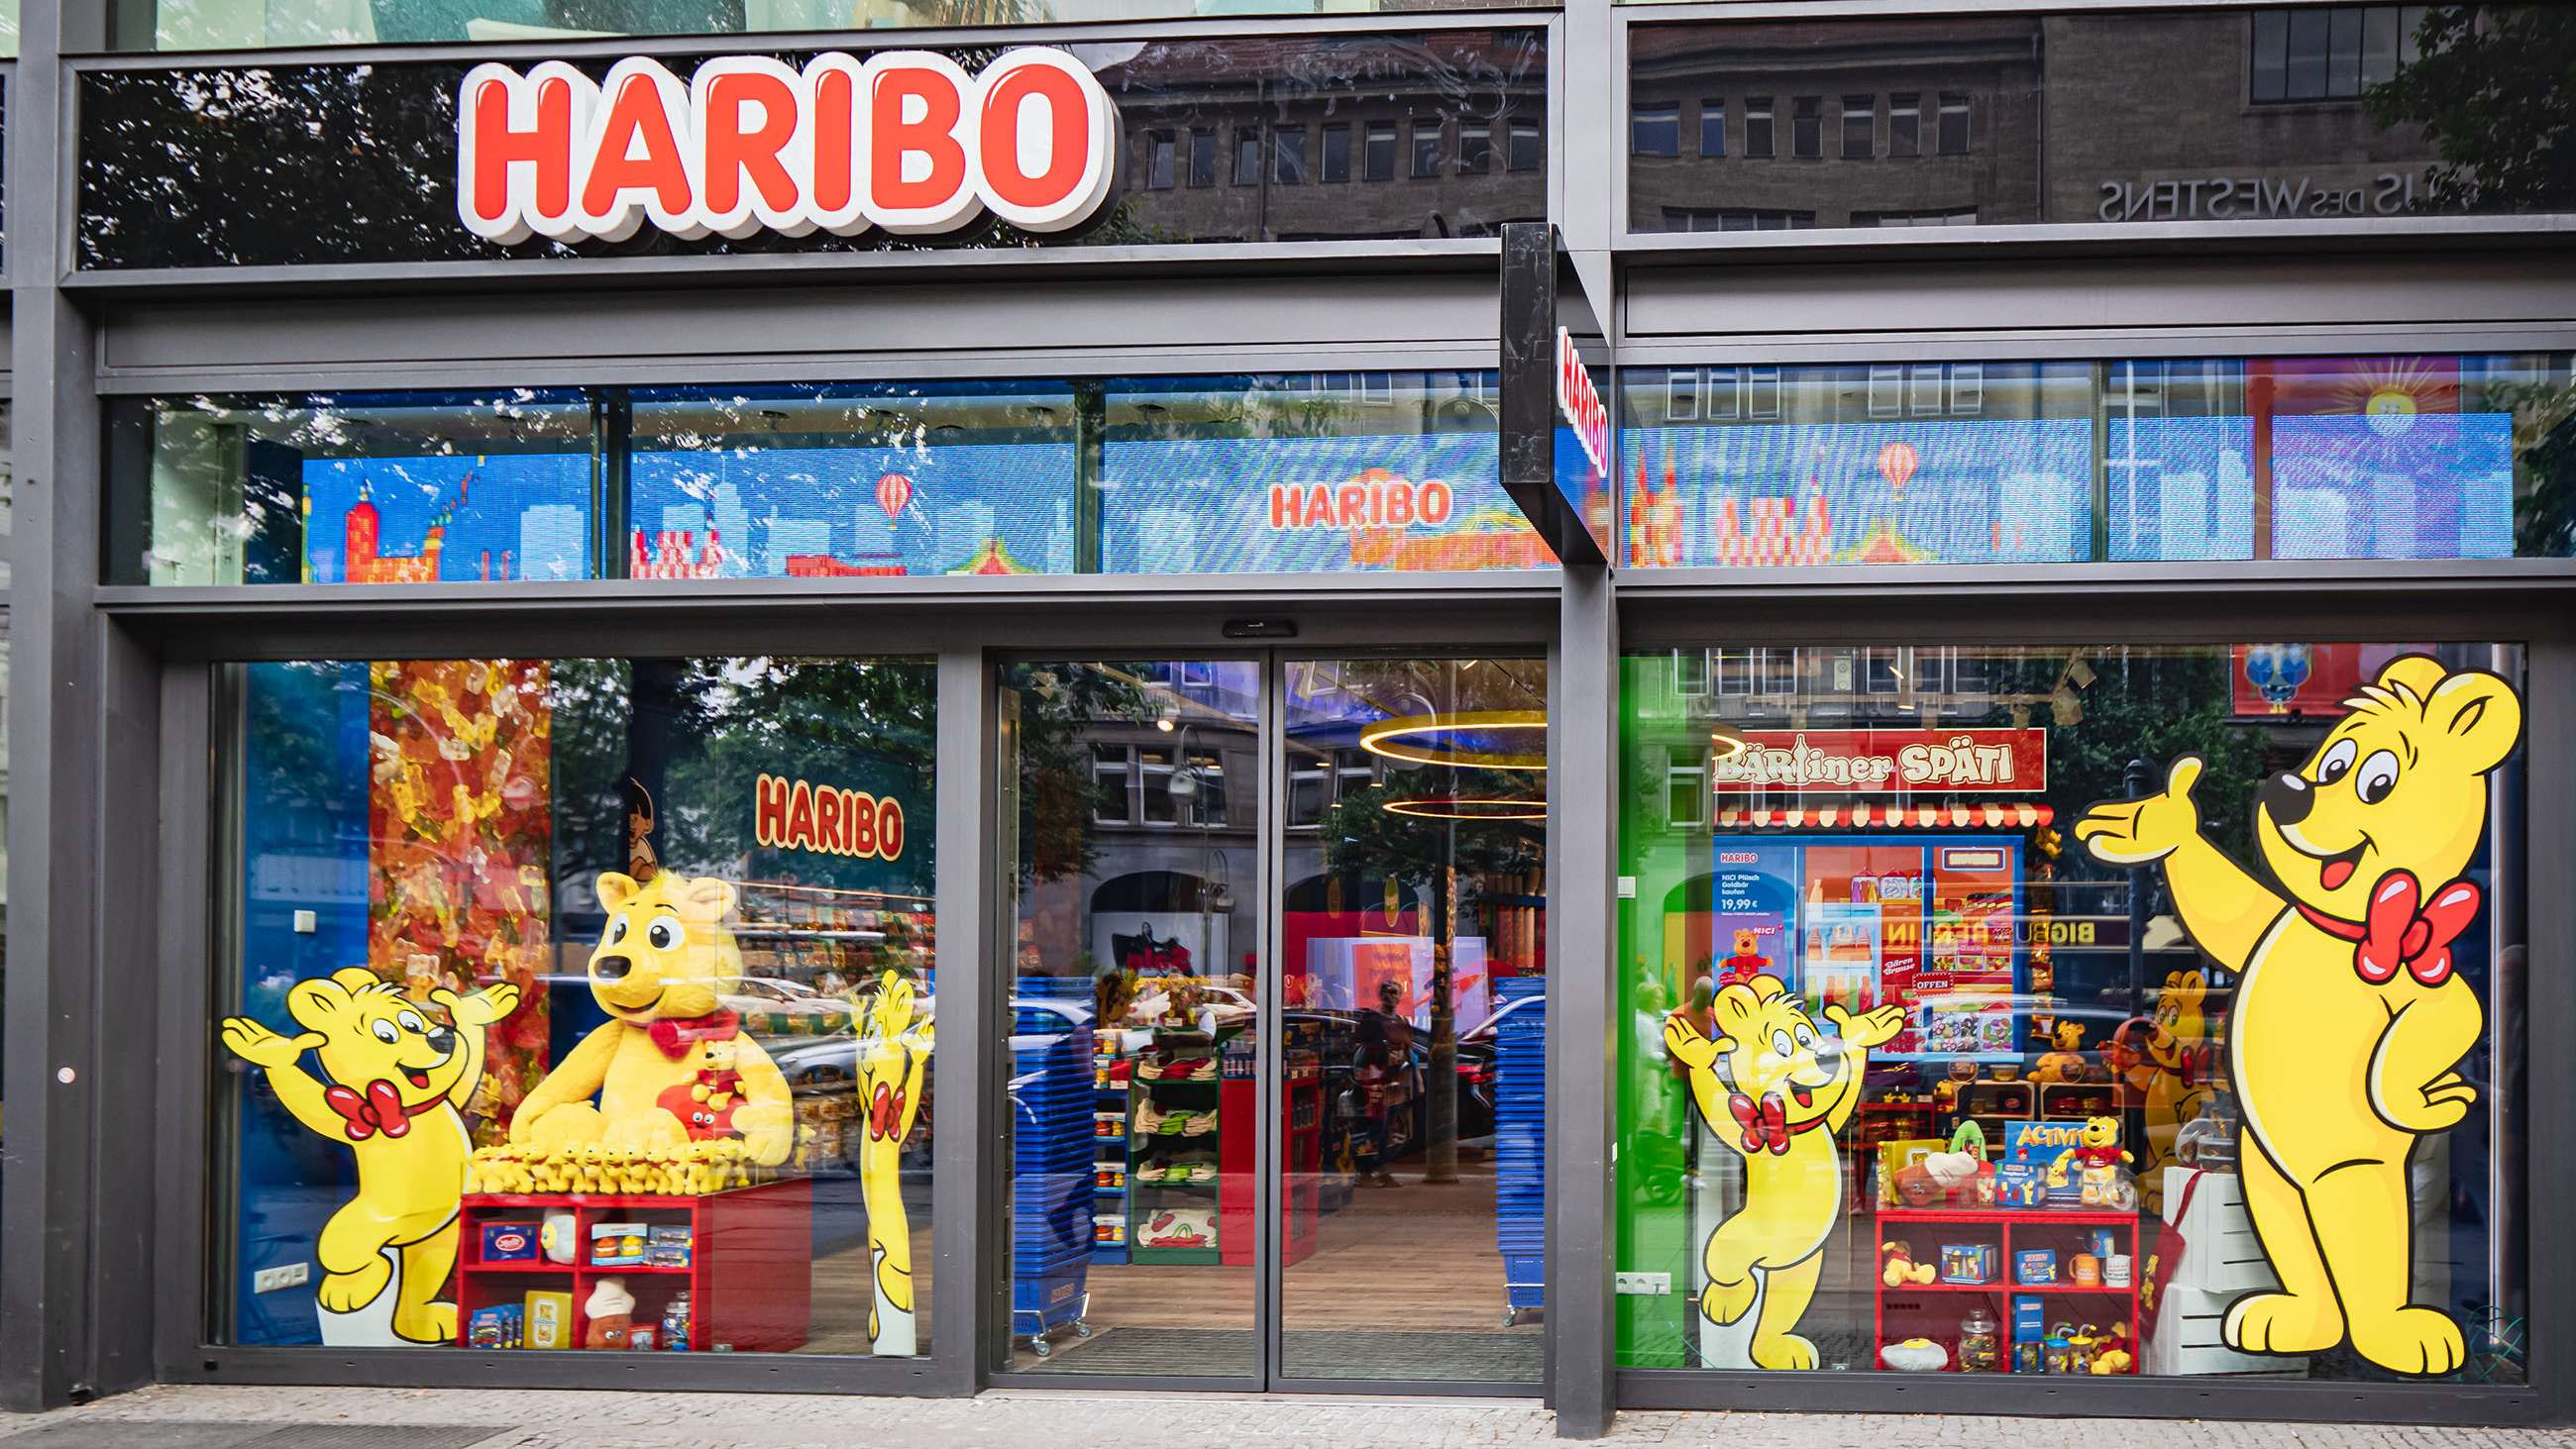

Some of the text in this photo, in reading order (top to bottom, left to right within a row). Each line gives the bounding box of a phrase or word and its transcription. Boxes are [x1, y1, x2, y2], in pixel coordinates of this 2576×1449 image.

[459, 47, 1114, 242] HARIBO
[1557, 326, 1608, 477] HARIBO
[1268, 481, 1453, 530] HARIBO
[1900, 735, 2014, 784] SPÄTI
[756, 773, 904, 862] HARIBO
[1721, 853, 1758, 863] HARIBO
[1753, 926, 1775, 935] NICI
[1917, 981, 1948, 989] OFFEN
